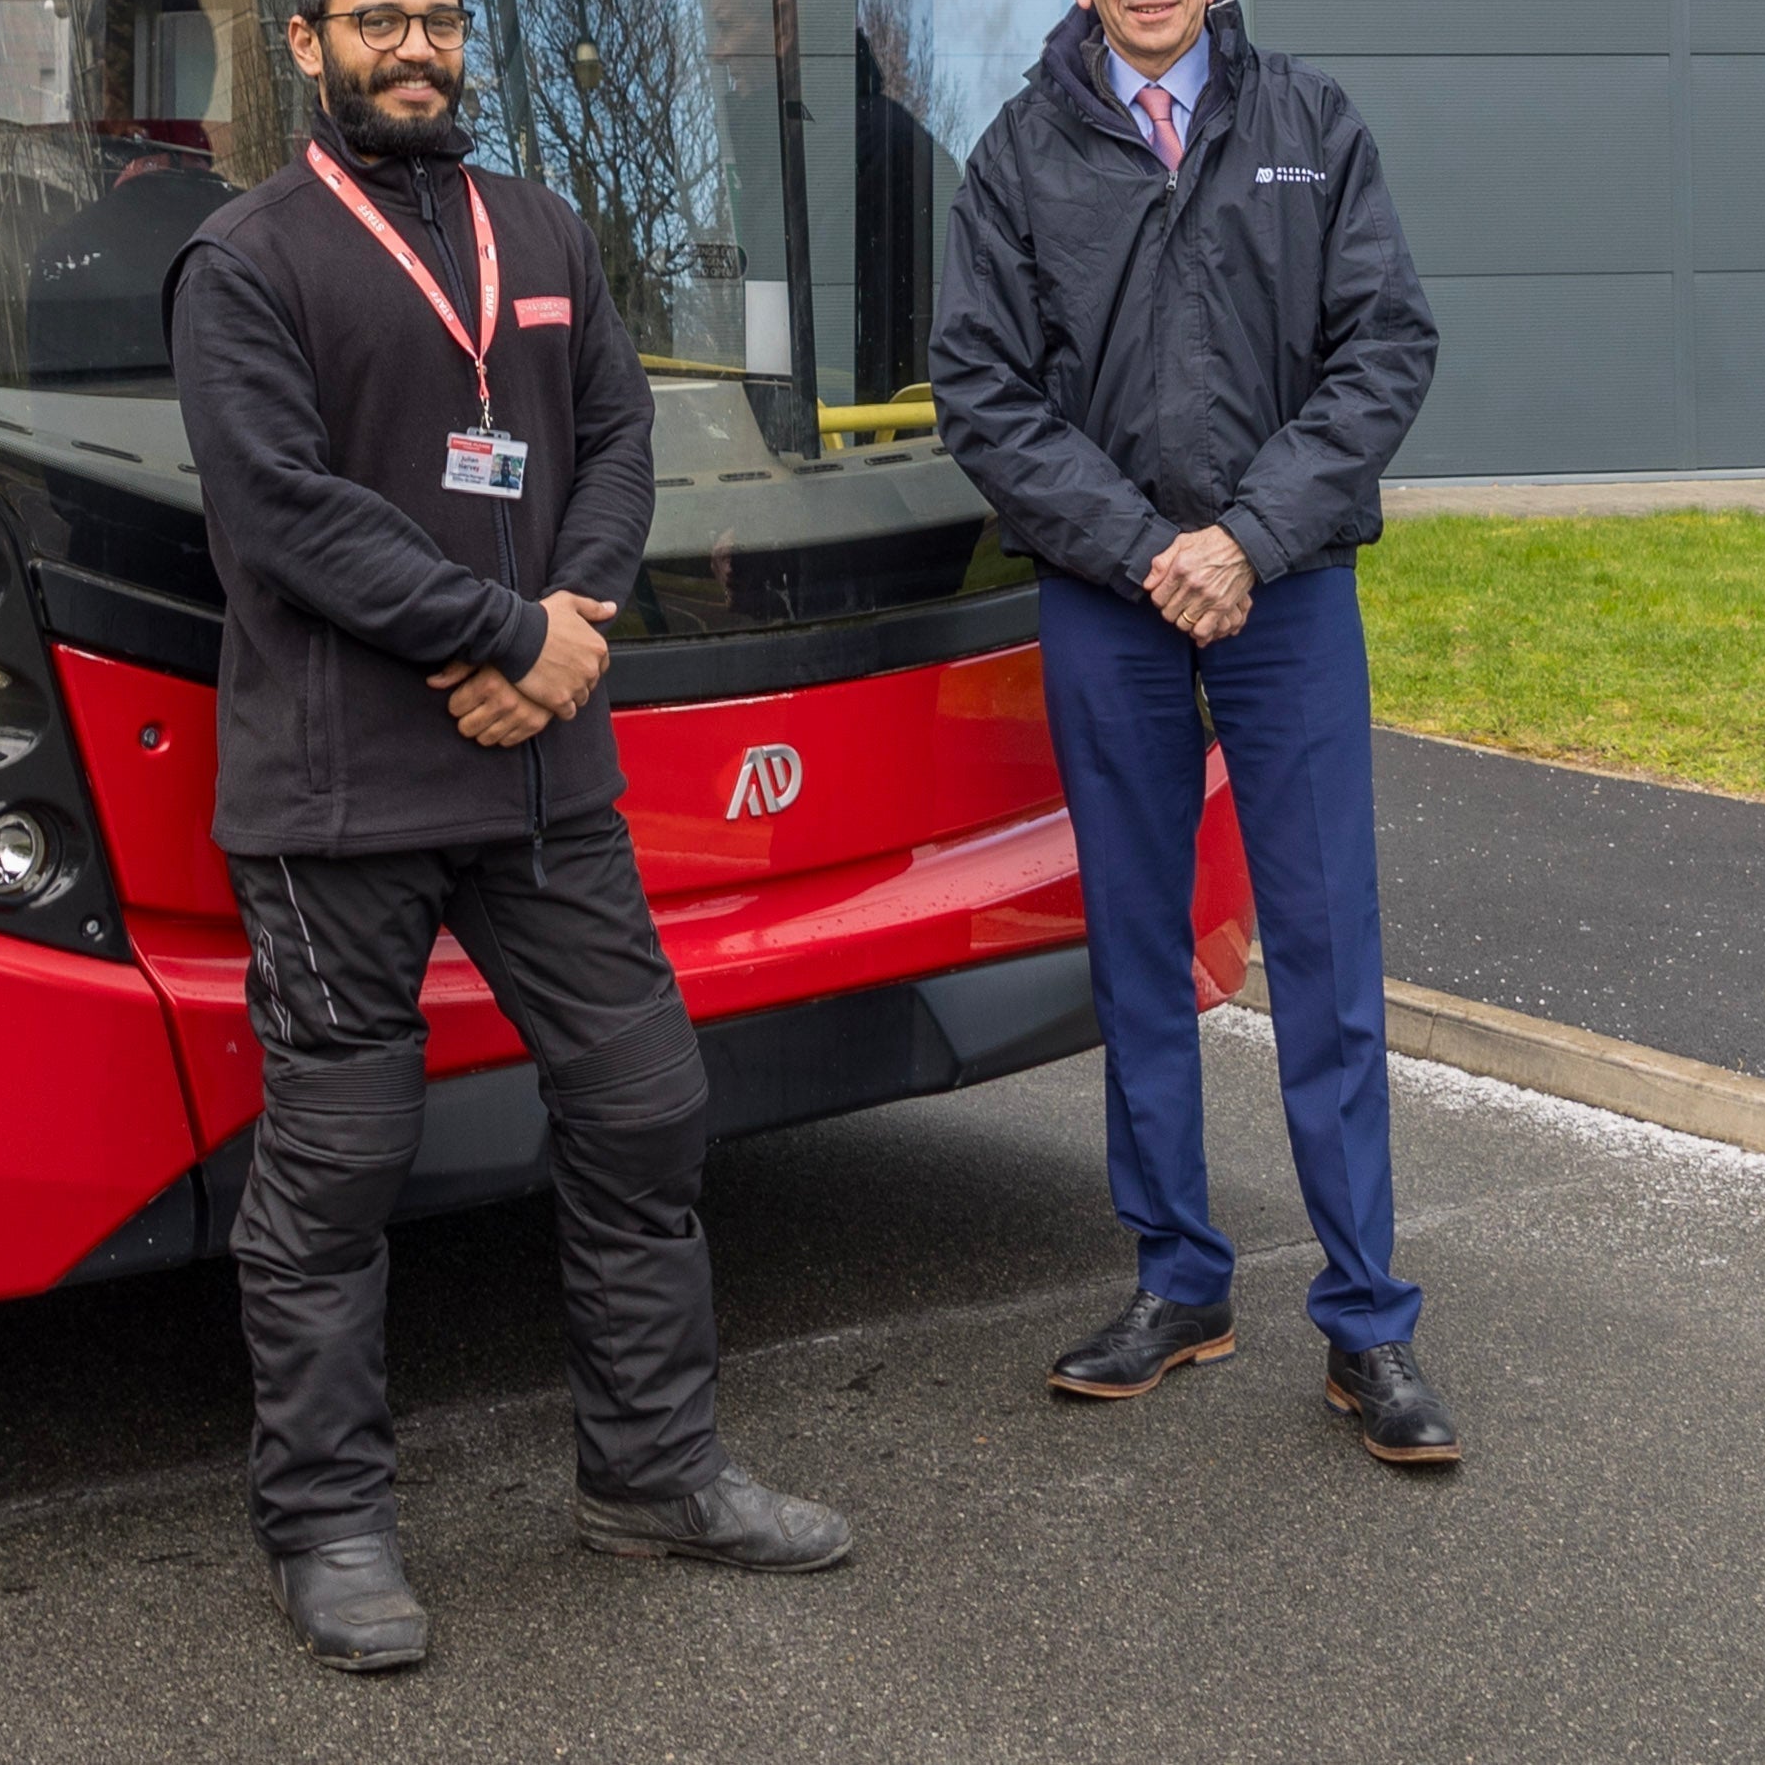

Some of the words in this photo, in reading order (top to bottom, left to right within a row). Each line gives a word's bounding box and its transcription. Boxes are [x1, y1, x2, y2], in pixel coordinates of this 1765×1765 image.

[1276, 166, 1326, 180] ALEXANER
[357, 204, 385, 233] STAFF
[430, 291, 454, 322] STAFF
[485, 285, 494, 319] STAFF
